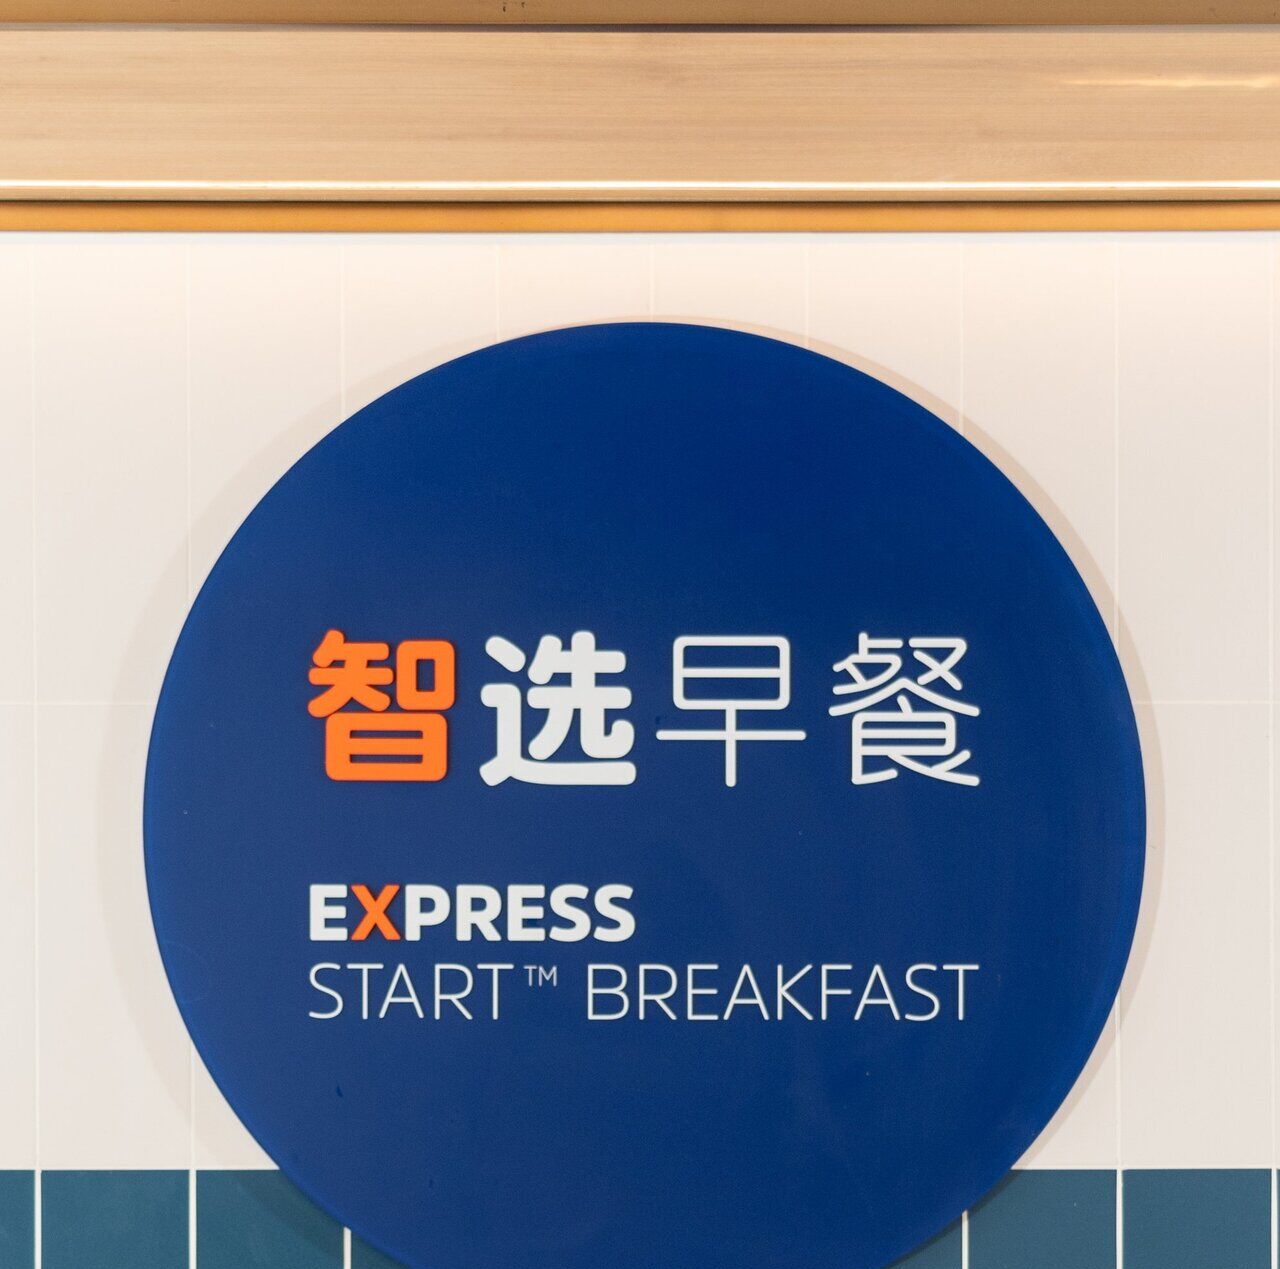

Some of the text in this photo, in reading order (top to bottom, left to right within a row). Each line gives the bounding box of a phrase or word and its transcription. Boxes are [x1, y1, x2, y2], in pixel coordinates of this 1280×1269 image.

[307, 628, 981, 788] 智选早餐
[308, 883, 636, 943] EXPRESS
[586, 963, 980, 1022] BREAKFAST
